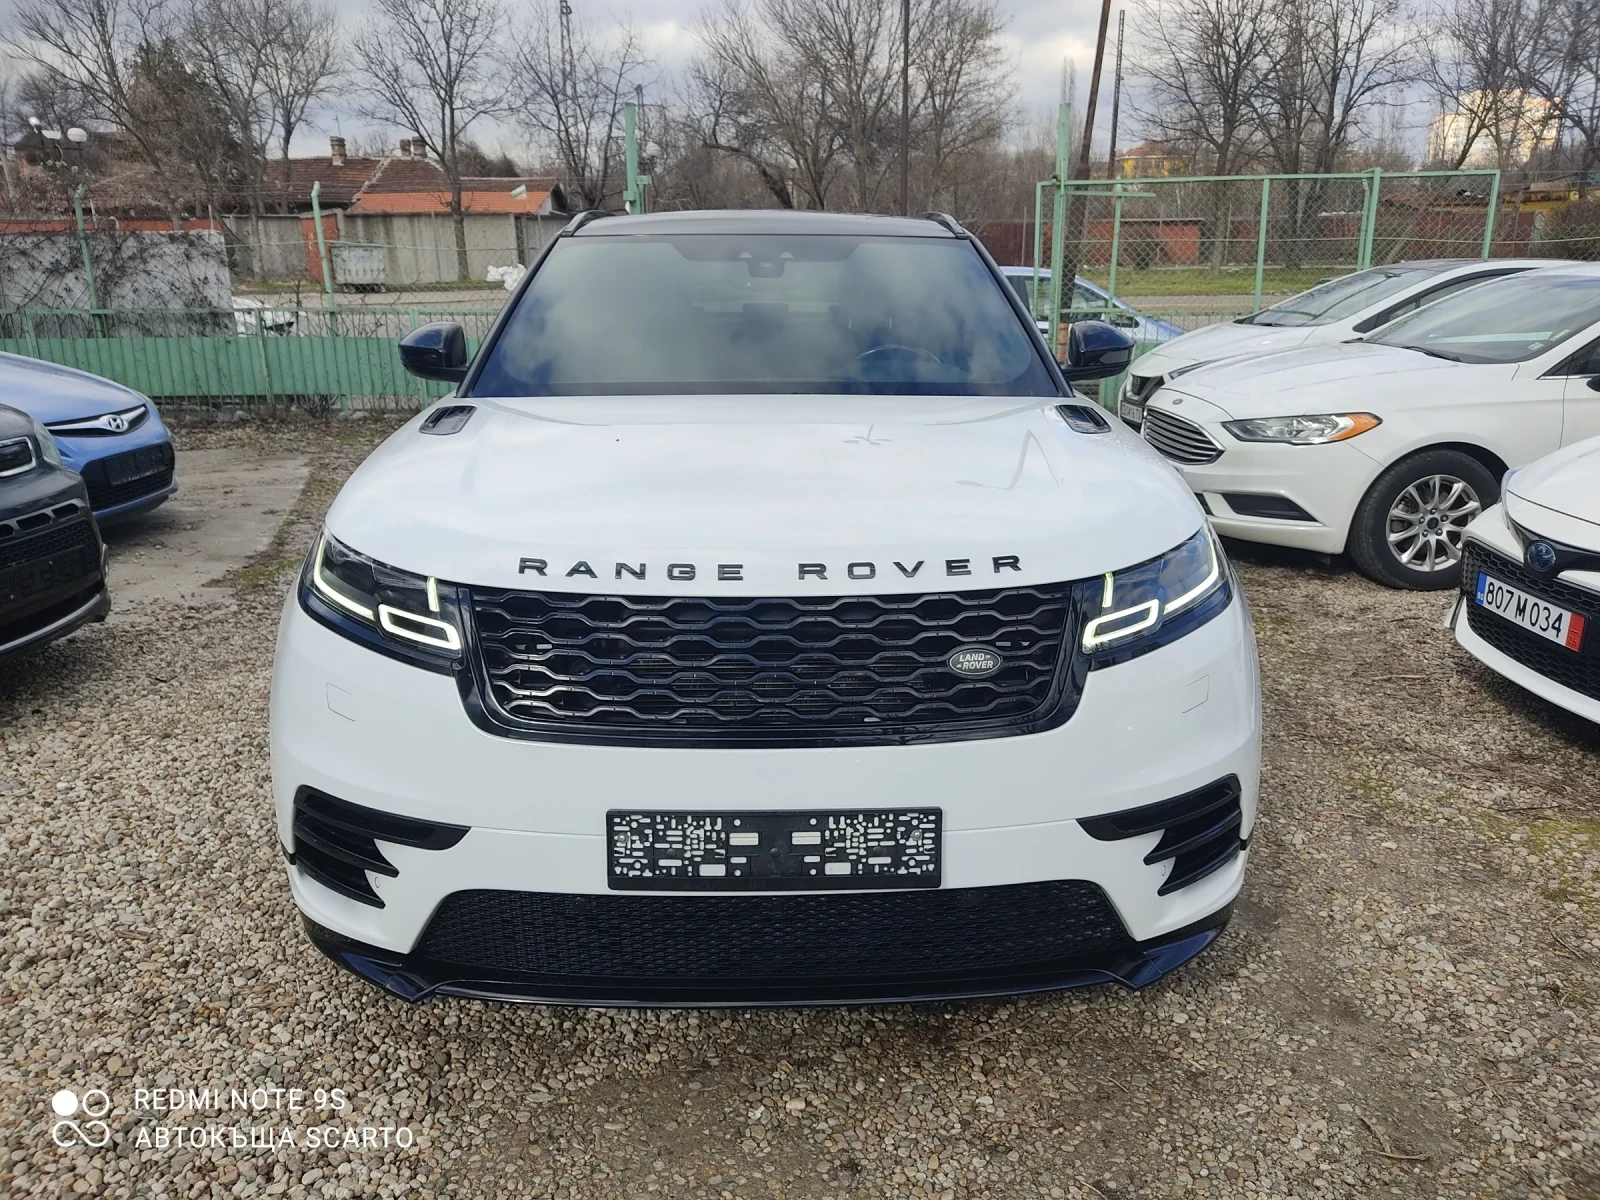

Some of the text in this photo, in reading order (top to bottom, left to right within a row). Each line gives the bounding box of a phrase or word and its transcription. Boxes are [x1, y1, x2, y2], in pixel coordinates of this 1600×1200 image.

[518, 554, 1022, 582] RANGE ROVER
[959, 653, 984, 661] LAND
[963, 661, 993, 669] ROVER
